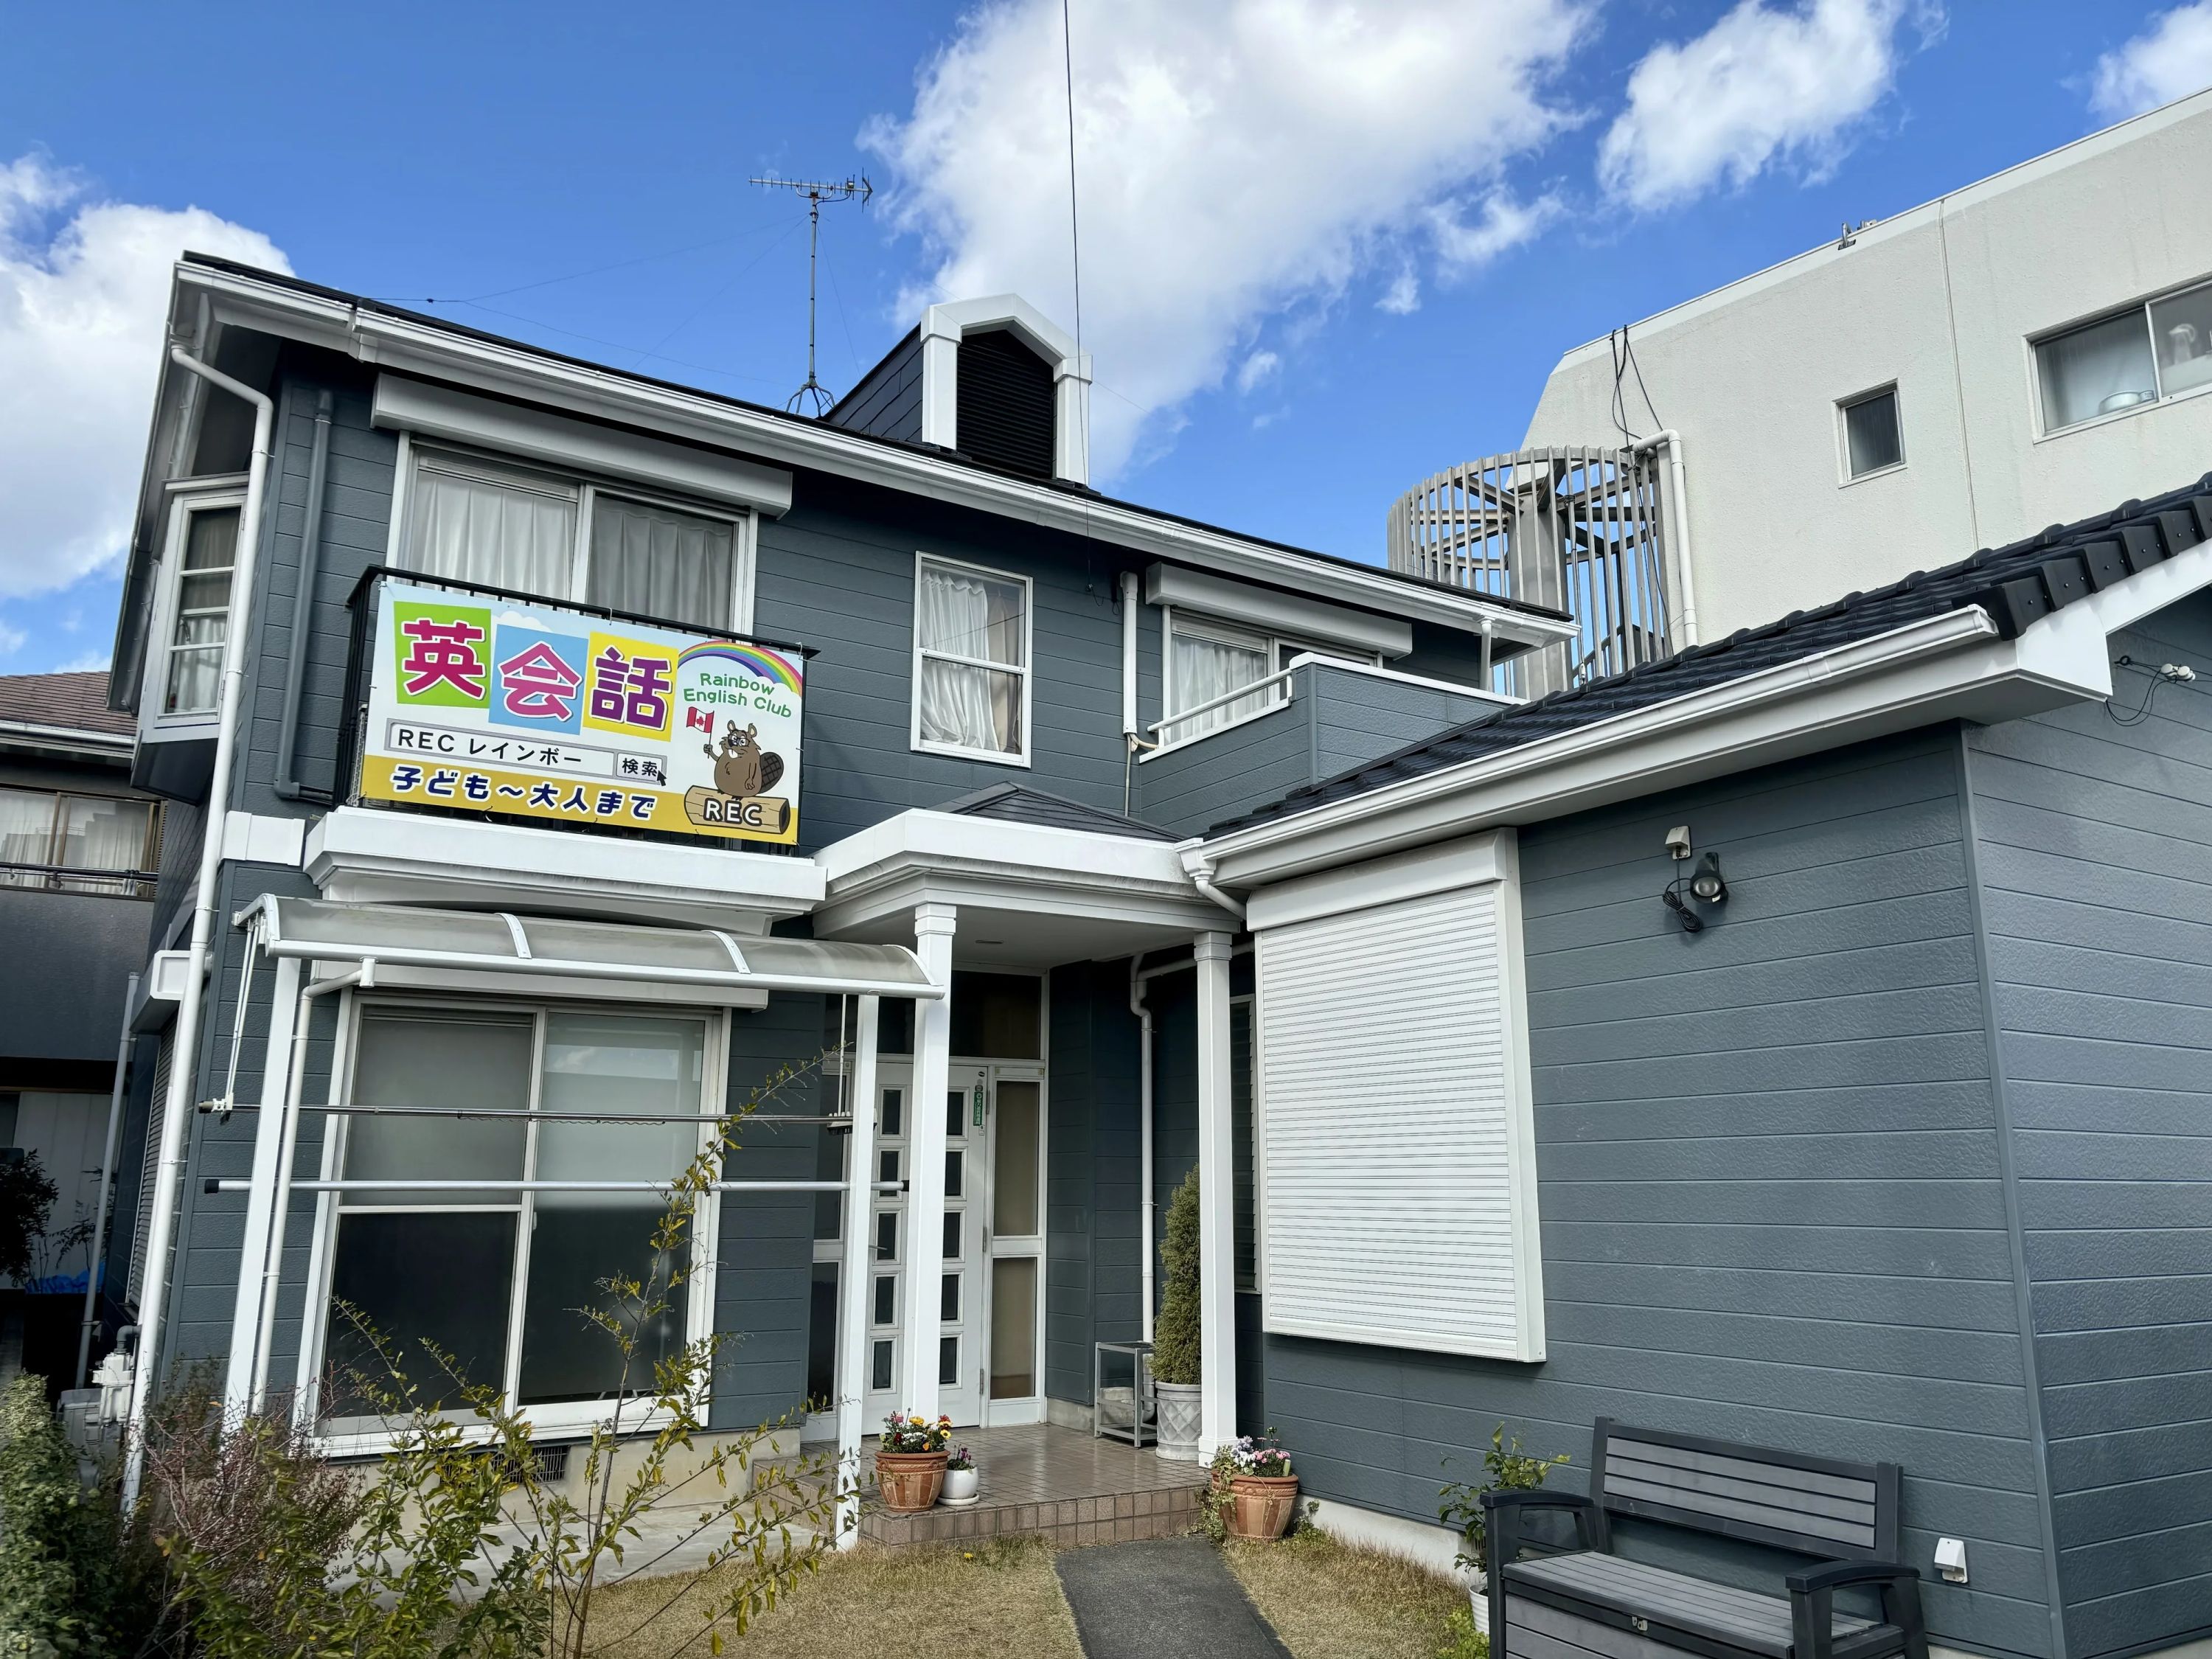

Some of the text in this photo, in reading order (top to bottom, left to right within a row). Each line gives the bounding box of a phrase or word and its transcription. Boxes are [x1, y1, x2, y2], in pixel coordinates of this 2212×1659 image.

[403, 619, 669, 729] 英会話
[700, 672, 775, 695] Rainbow
[684, 688, 792, 717] English Club
[397, 728, 582, 765] REC レインボー
[622, 757, 658, 778] 検索
[704, 799, 762, 825] REC
